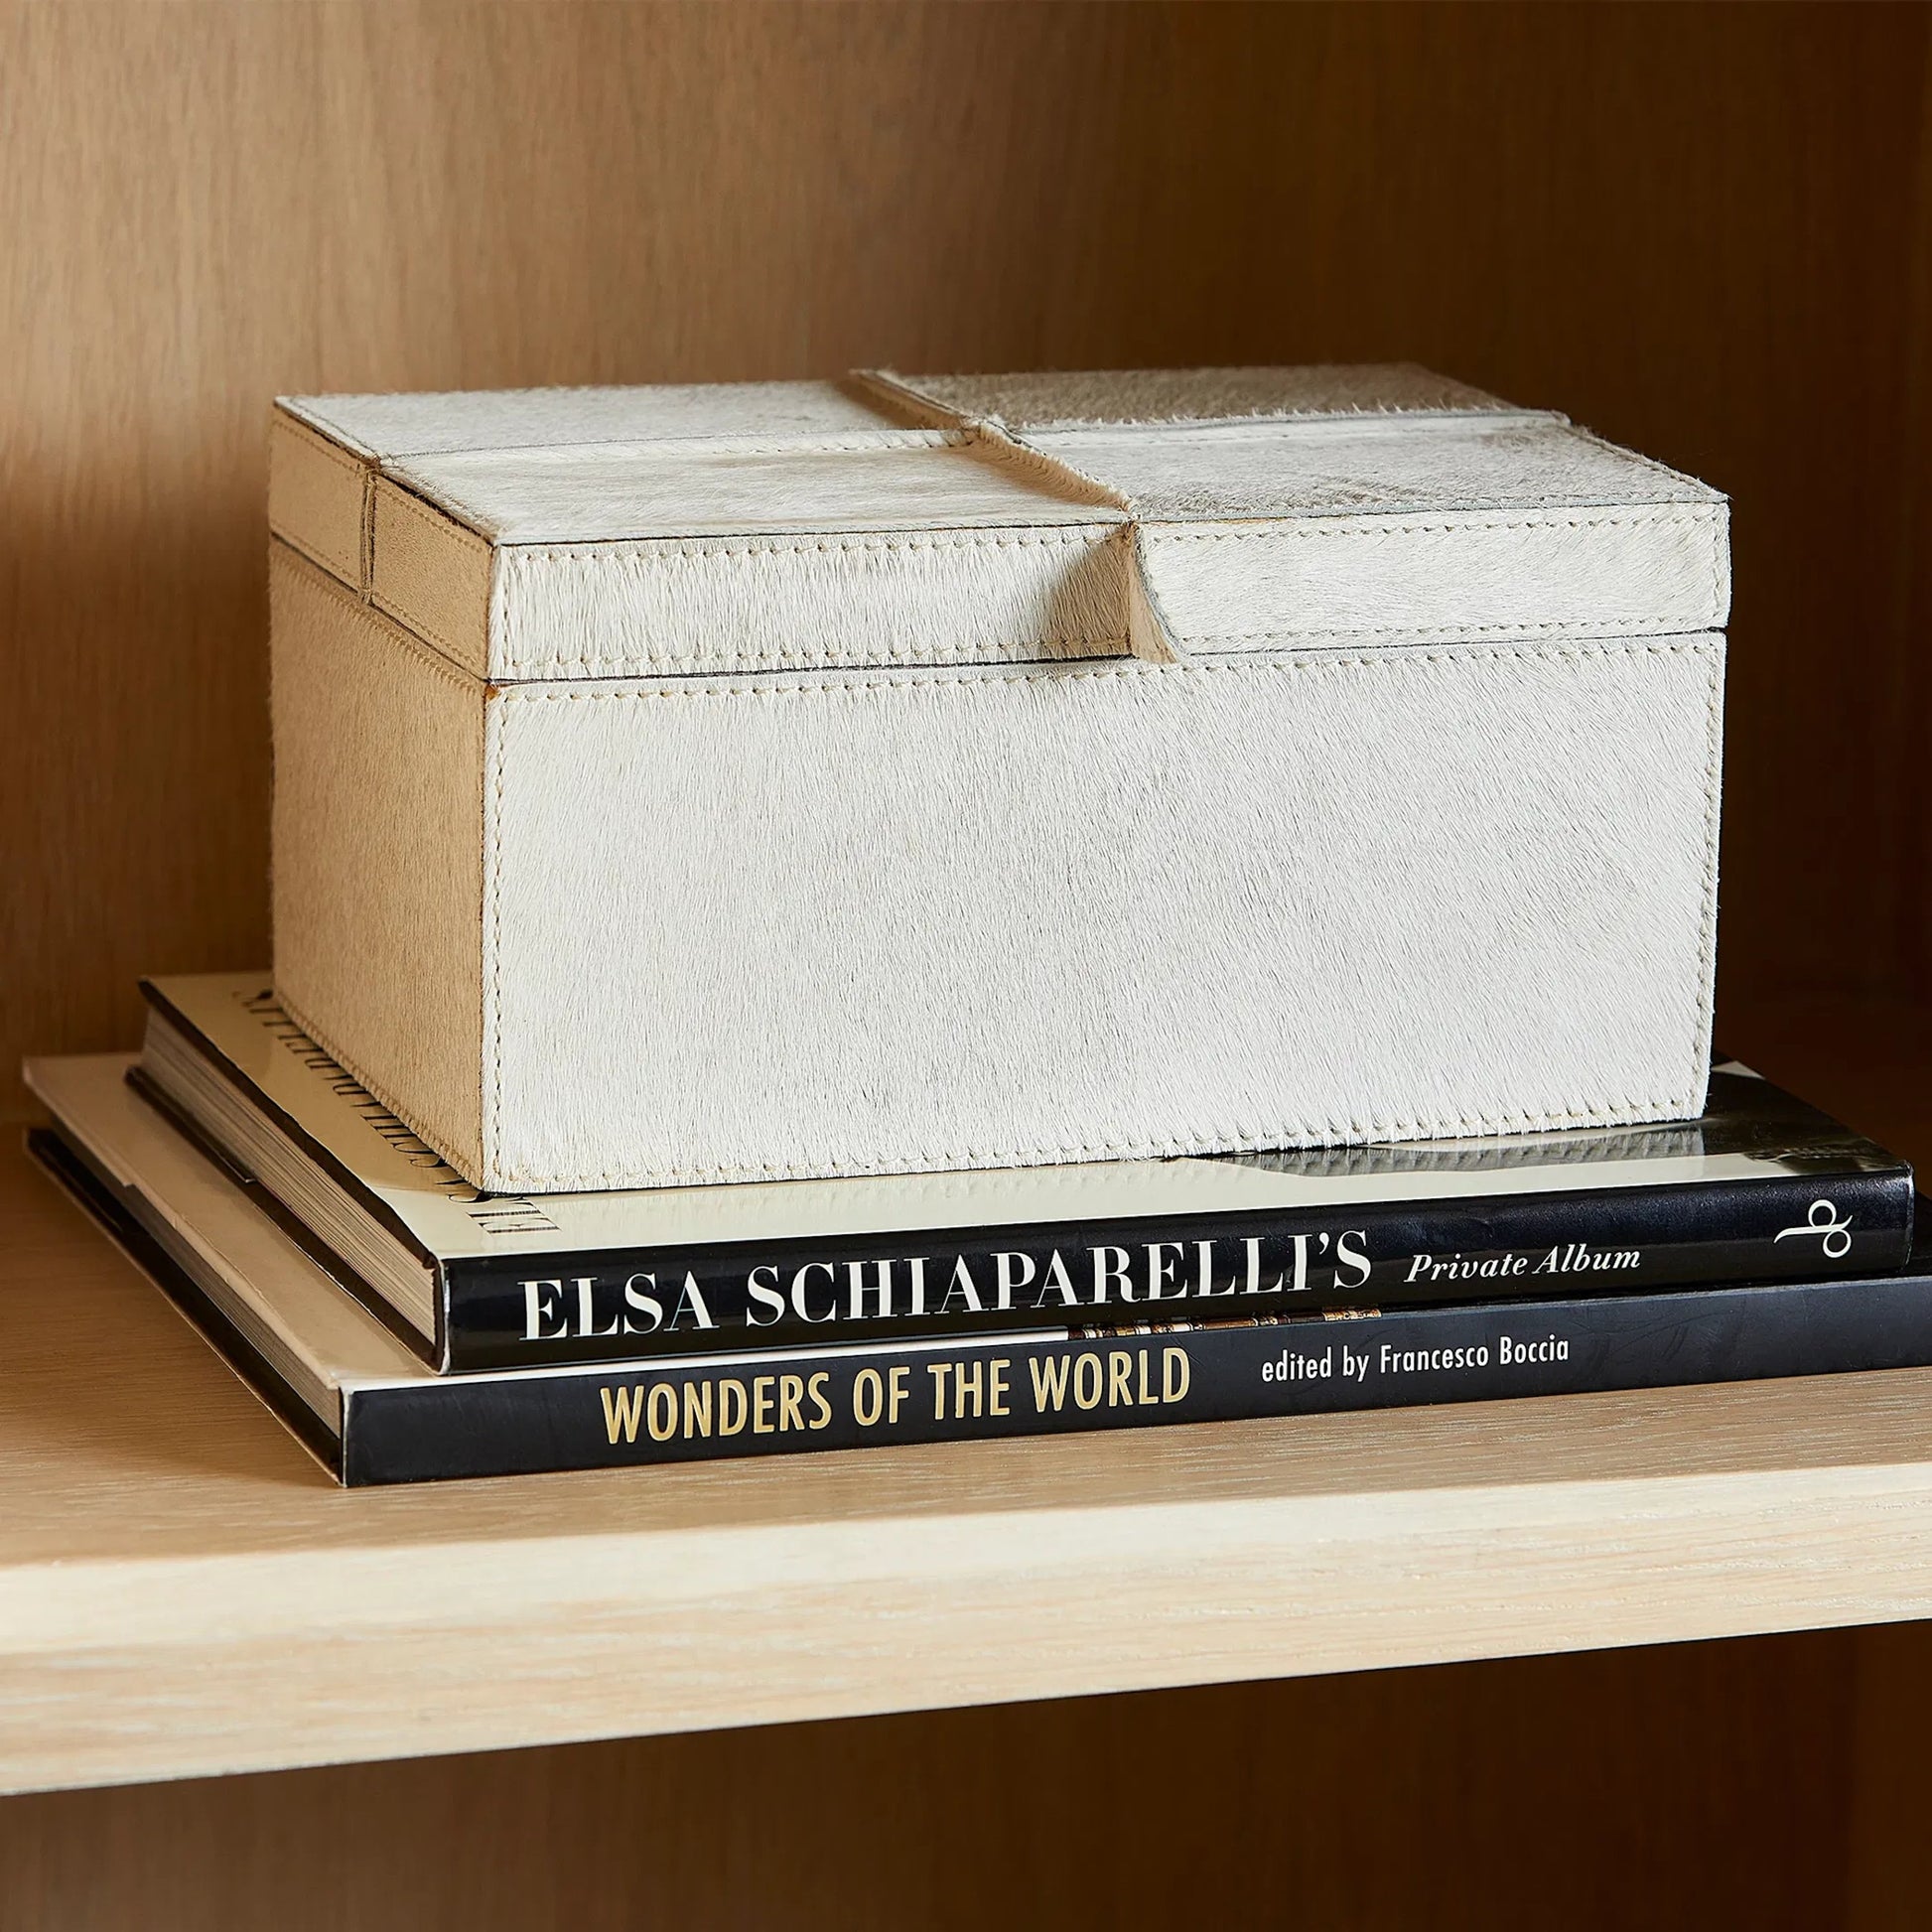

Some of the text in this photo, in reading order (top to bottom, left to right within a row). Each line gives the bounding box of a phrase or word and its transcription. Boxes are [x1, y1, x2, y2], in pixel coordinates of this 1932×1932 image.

[518, 1270, 719, 1341] ELSA
[1403, 1253, 1526, 1284] Private
[1532, 1243, 1641, 1275] Album
[600, 1334, 1569, 1445] WONDERS OF THE WORLD edited by Francesco Boccia
